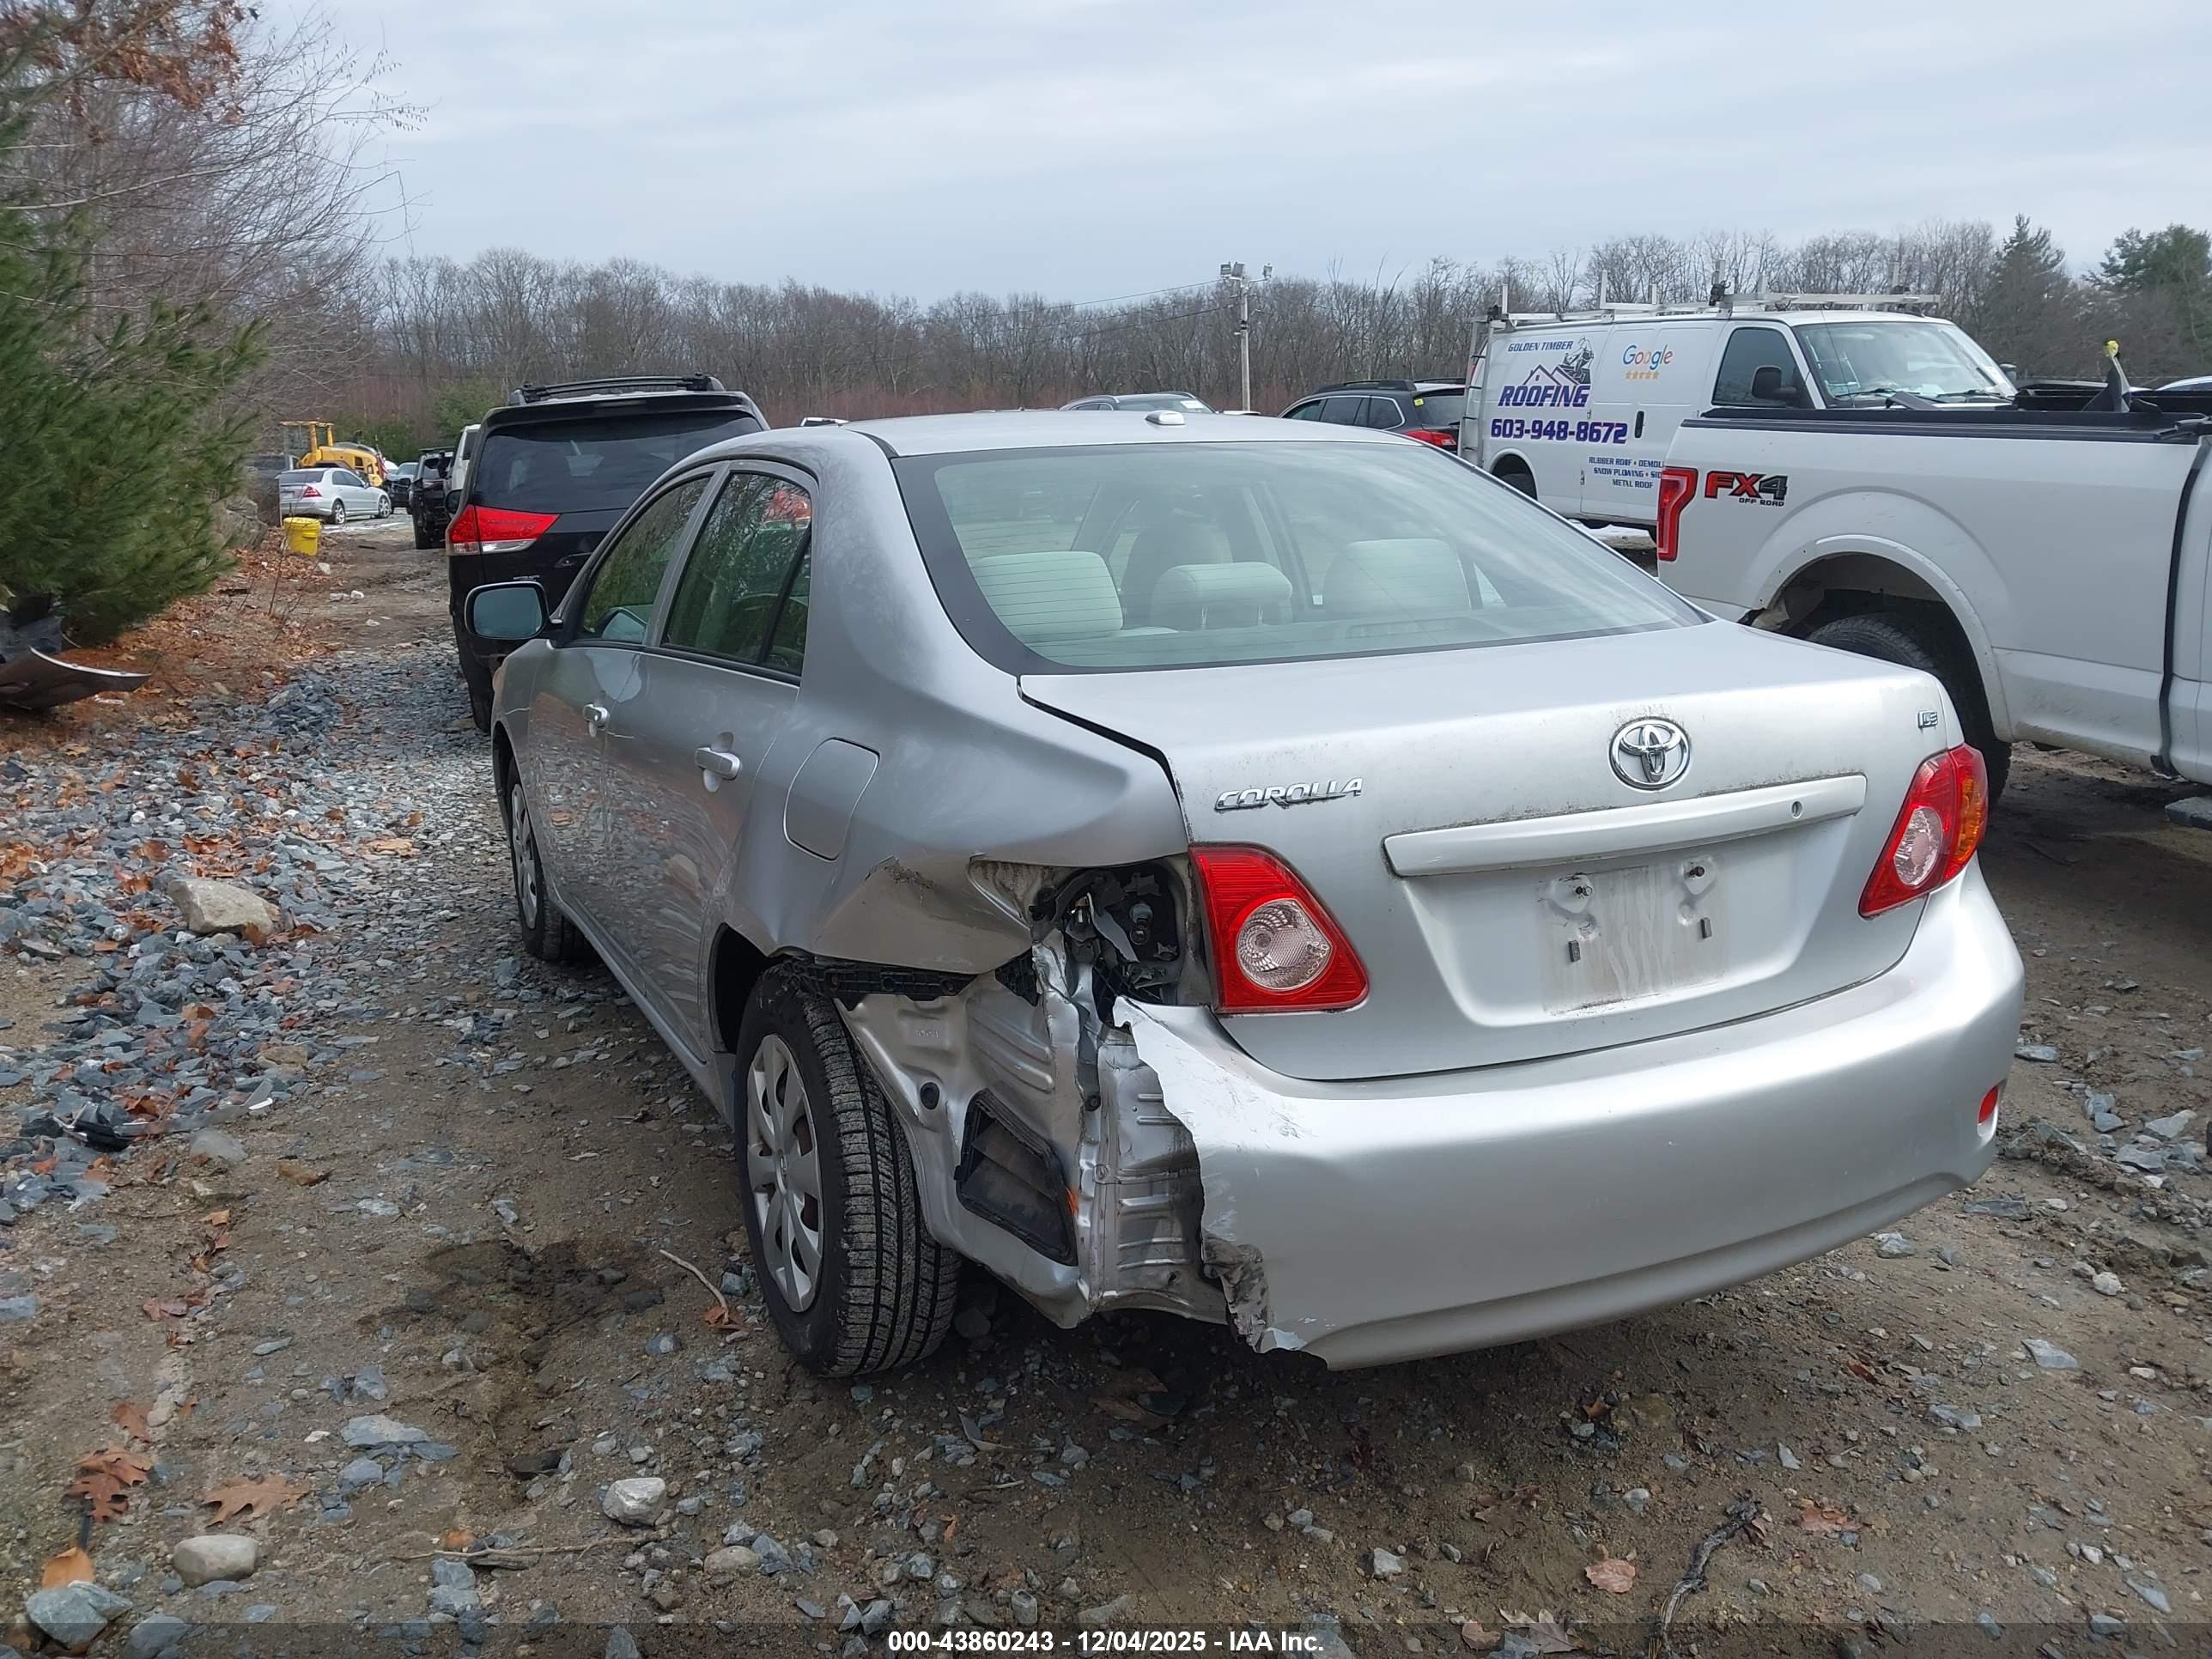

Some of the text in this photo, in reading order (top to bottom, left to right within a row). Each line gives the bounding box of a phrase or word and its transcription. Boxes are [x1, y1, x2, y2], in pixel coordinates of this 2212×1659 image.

[1508, 341, 1574, 352] GOLDEN TIMBER
[1622, 344, 1674, 370] Google
[1498, 385, 1591, 408] ROOFING
[1491, 418, 1629, 444] 603-948-8672
[1589, 456, 1614, 465] RUBBER
[1615, 458, 1632, 466] ROOF
[1594, 466, 1612, 475] SNOW
[1613, 468, 1644, 477] PLOWING
[1612, 478, 1654, 489] METAL ROOF
[1705, 470, 1788, 501] FX4
[1917, 711, 1938, 729] LE
[1214, 777, 1364, 811] COROLLA
